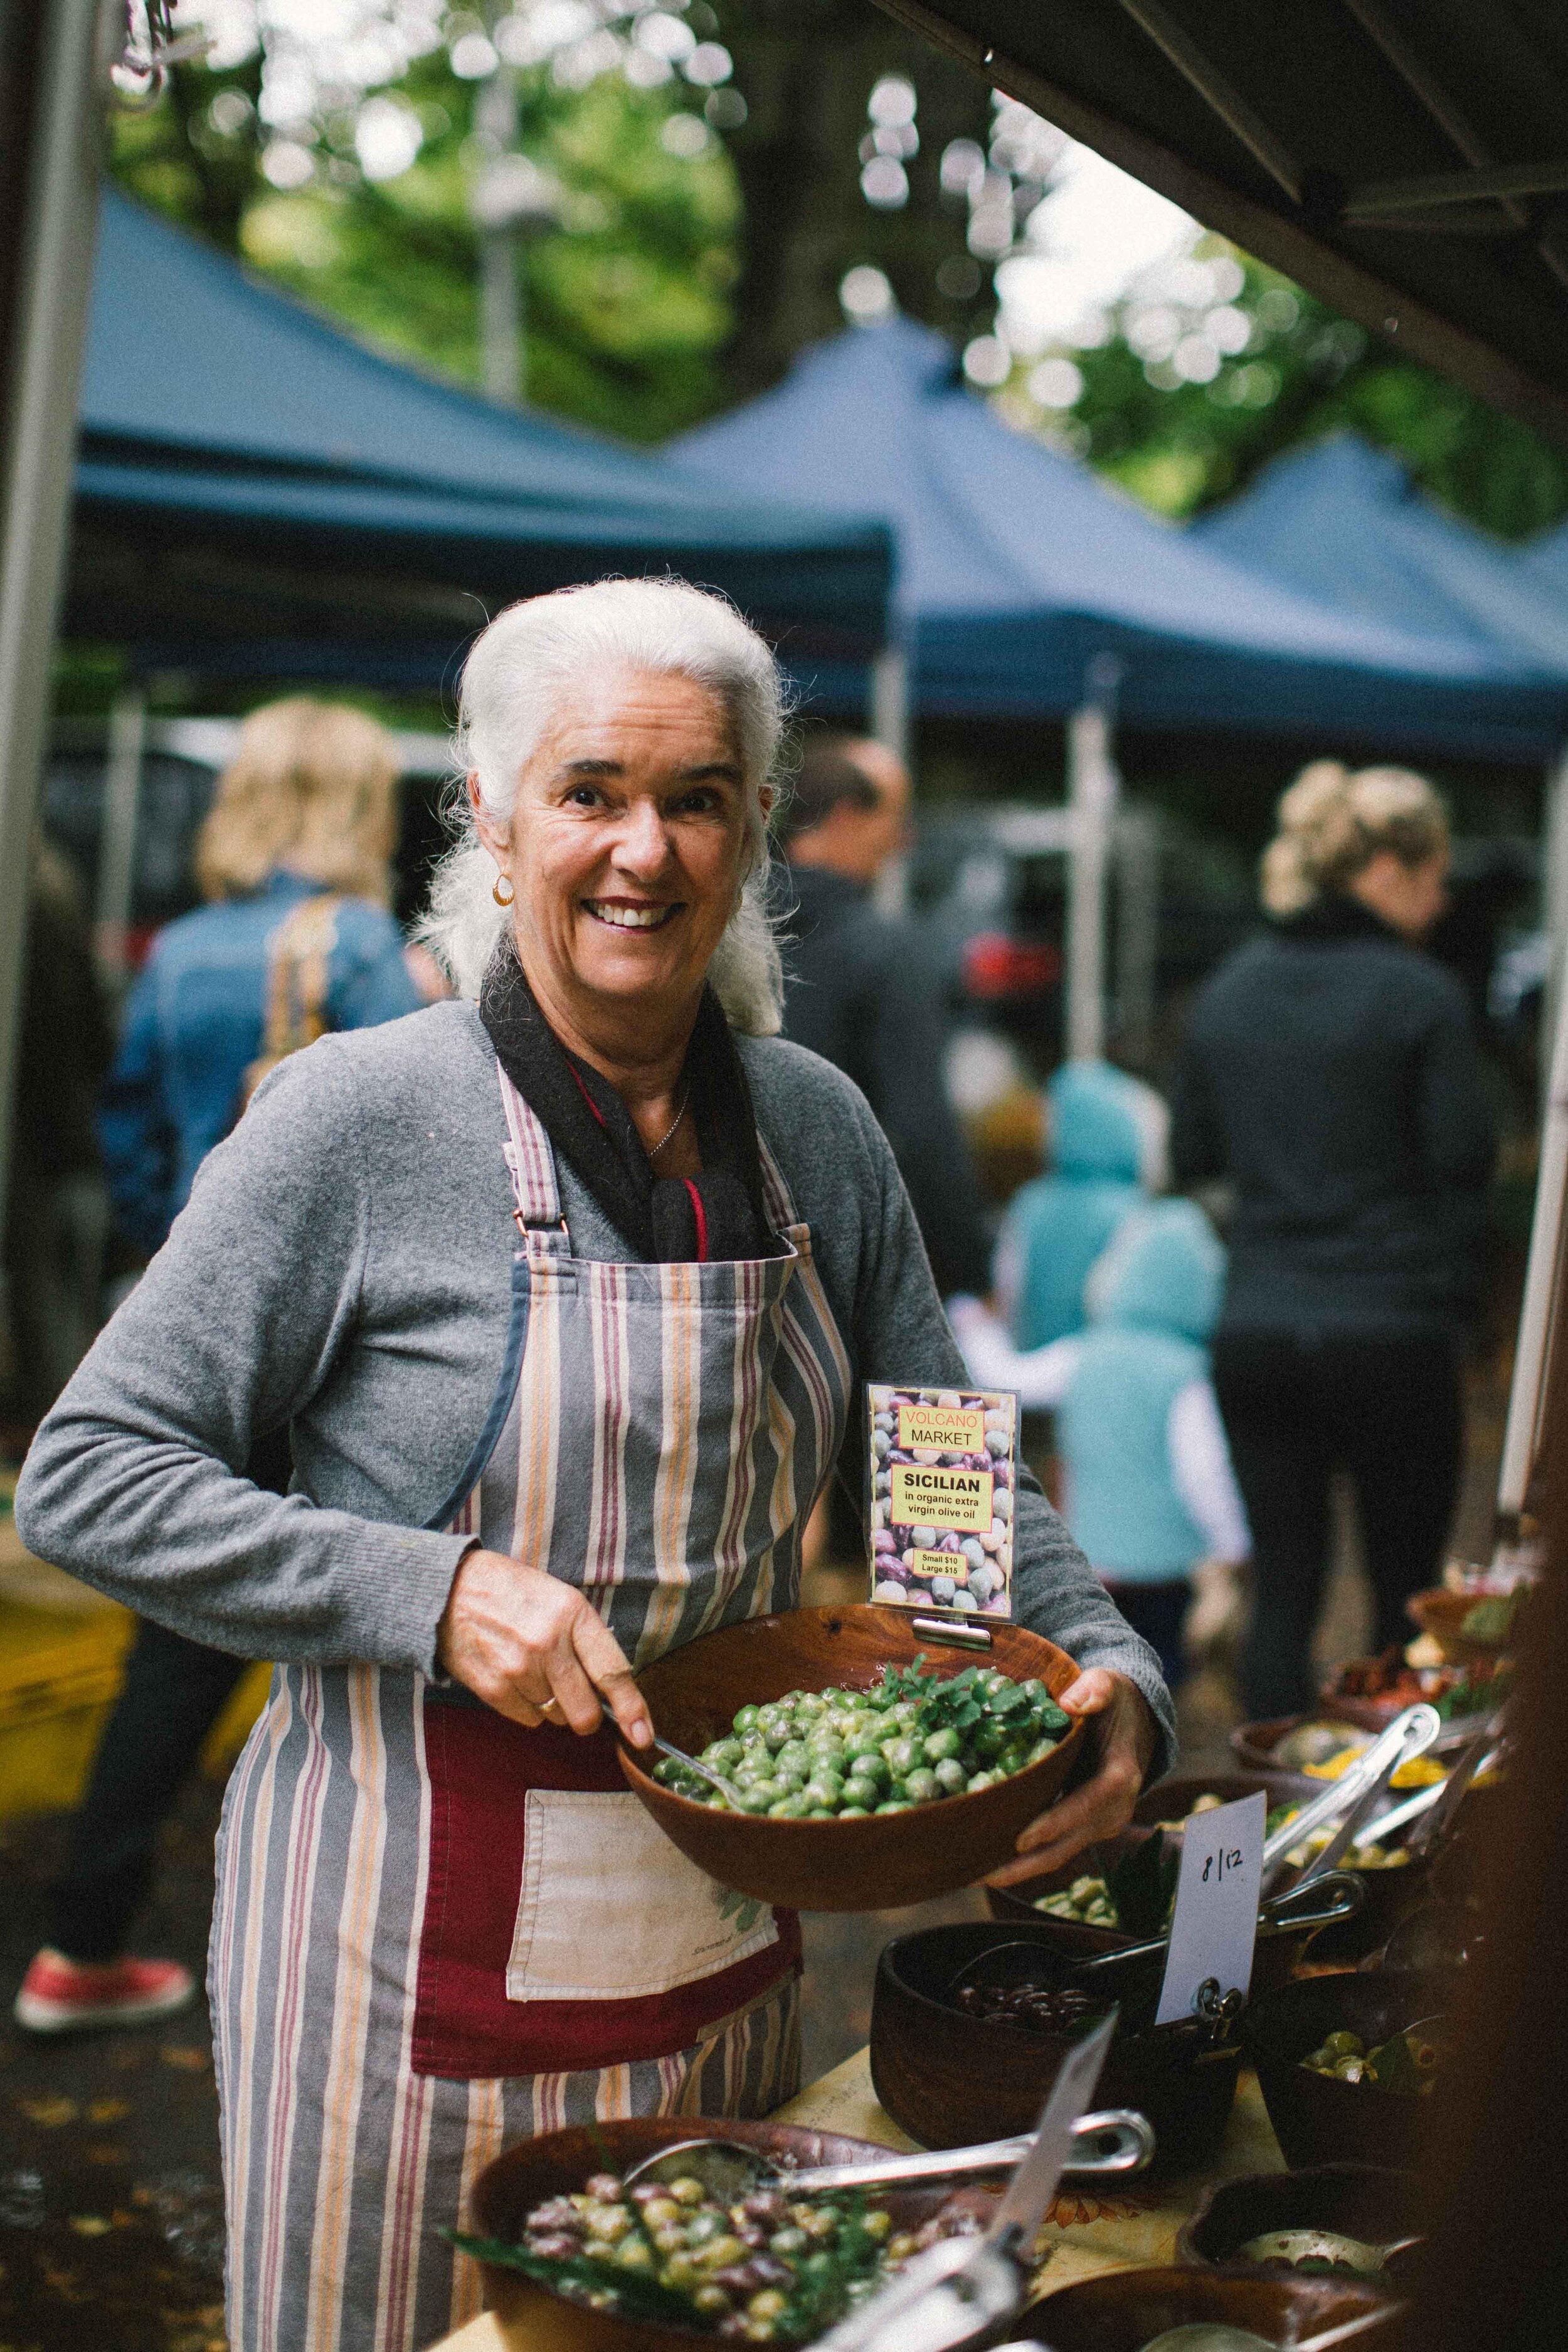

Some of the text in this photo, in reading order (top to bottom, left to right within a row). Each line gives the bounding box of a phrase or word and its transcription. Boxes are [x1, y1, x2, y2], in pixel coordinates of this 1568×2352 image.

[906, 1411, 977, 1428] VOLCANO
[912, 1429, 972, 1445] MARKET
[904, 1473, 980, 1492] SICILIAN
[906, 1491, 978, 1507] in organic extra
[909, 1505, 975, 1518] virgin olive oil
[923, 1554, 957, 1564] Small $10
[922, 1564, 957, 1574] Large $15
[1202, 1849, 1242, 1882] 8/12
